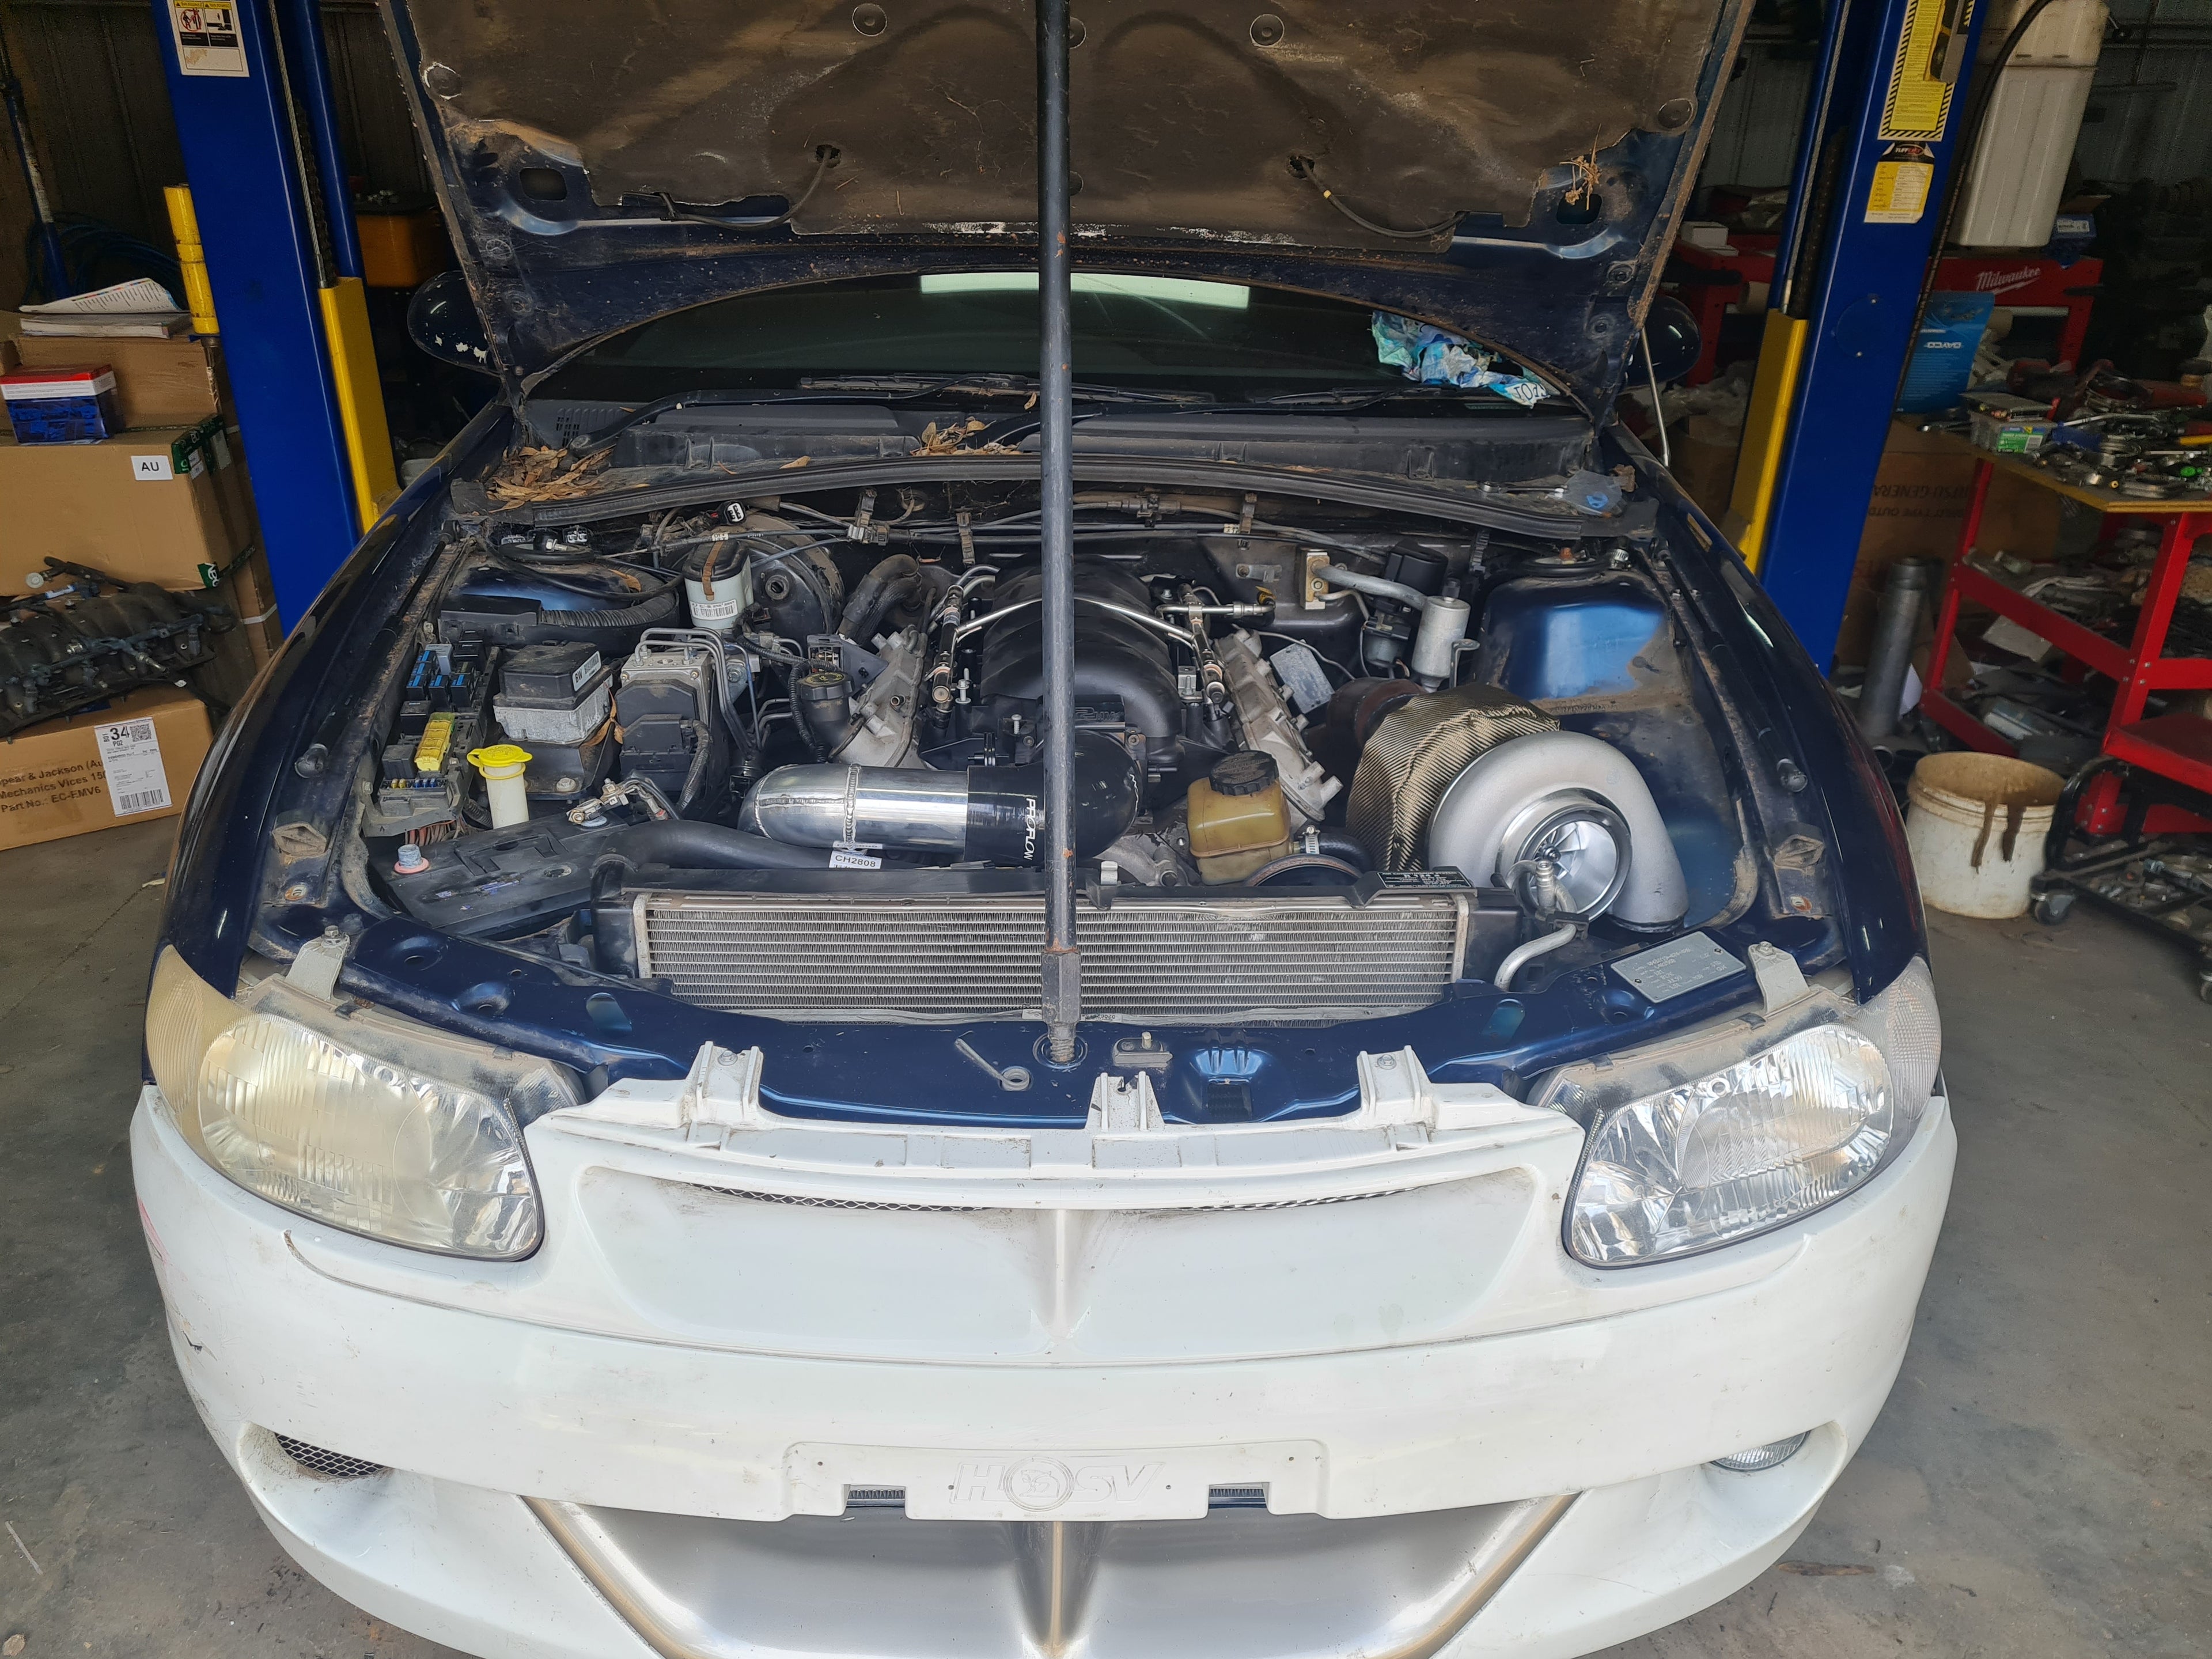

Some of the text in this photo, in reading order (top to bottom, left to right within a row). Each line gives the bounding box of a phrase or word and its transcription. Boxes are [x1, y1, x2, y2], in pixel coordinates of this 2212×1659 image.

[1976, 266, 2040, 291] Milwaukee
[141, 461, 160, 472] AU
[109, 726, 130, 741] 34
[0, 775, 25, 787] pear
[29, 772, 36, 781] &
[39, 764, 84, 779] Jackson
[0, 783, 56, 799] Mechanics
[58, 777, 88, 787] Vices
[1, 802, 24, 812] Part
[51, 786, 101, 804] EC-EMV6
[1024, 798, 1036, 861] PROFLOW
[835, 855, 876, 868] CH2808
